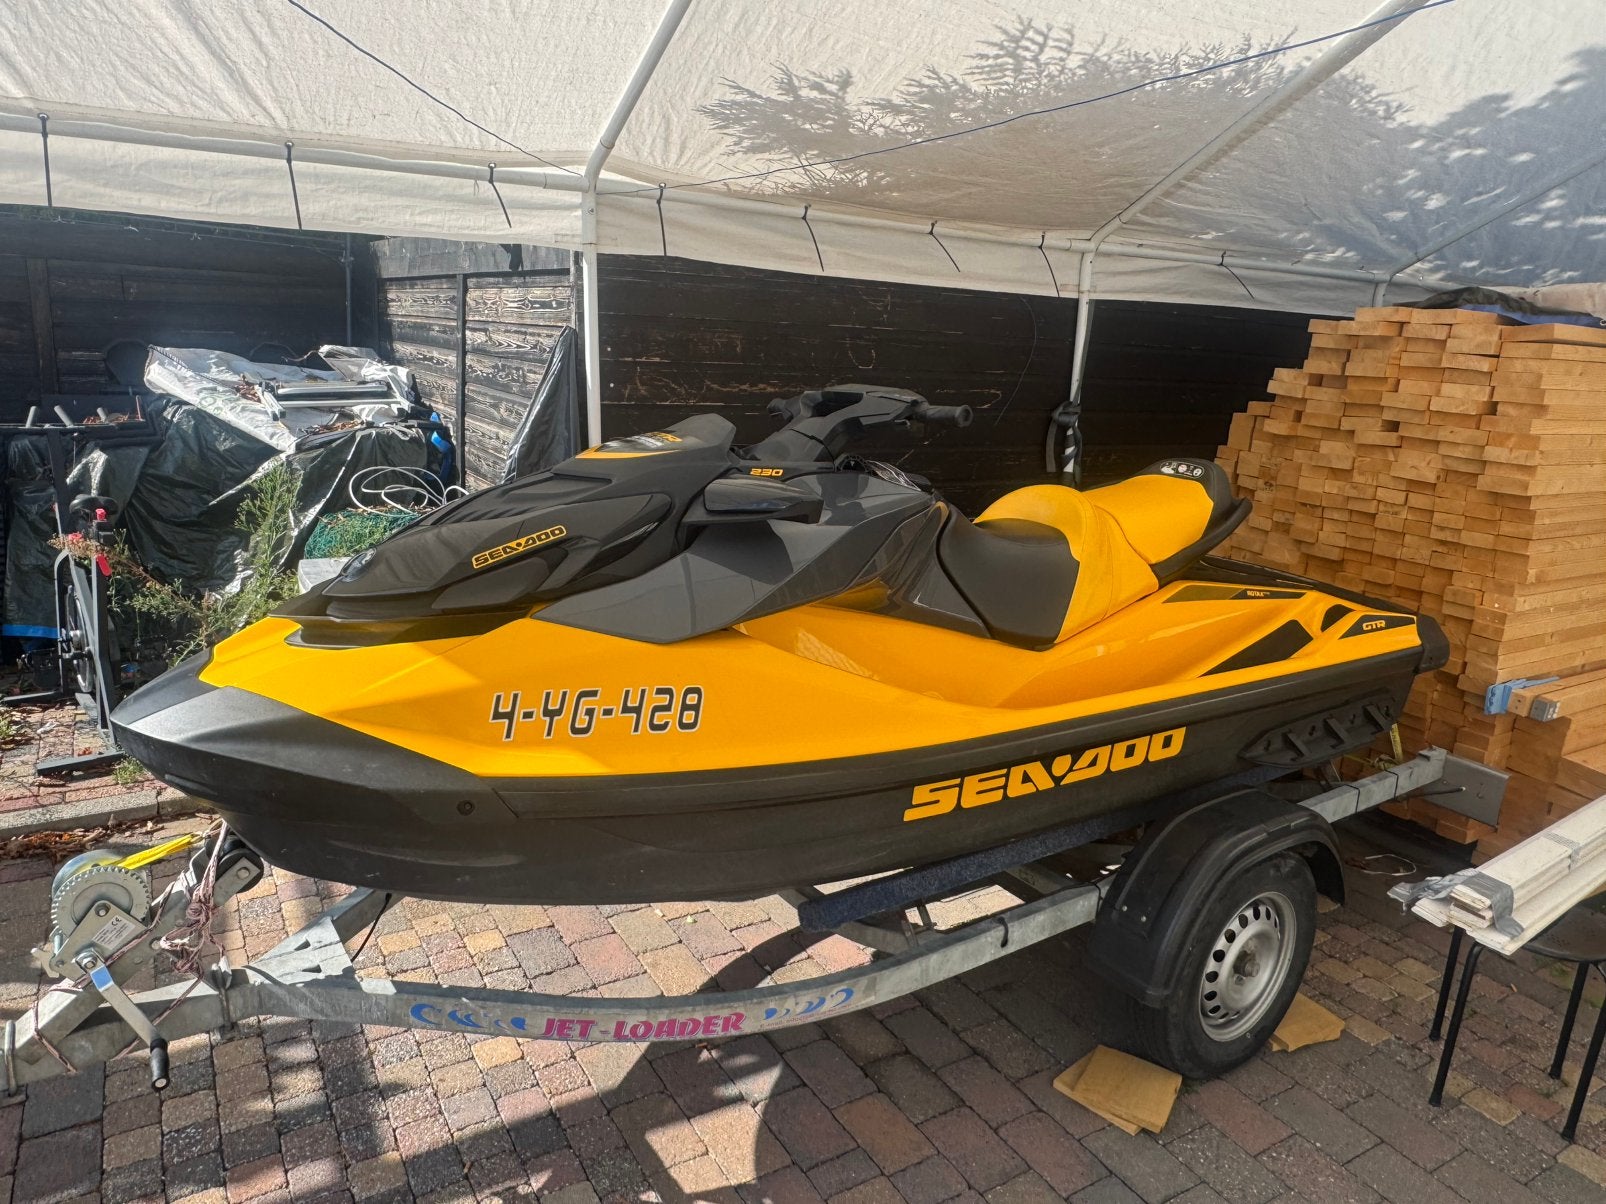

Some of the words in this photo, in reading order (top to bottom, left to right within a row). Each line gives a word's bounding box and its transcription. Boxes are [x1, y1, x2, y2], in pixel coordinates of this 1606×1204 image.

[750, 468, 784, 477] 230
[1362, 620, 1386, 631] GTR
[489, 685, 704, 742] 4-YG-428
